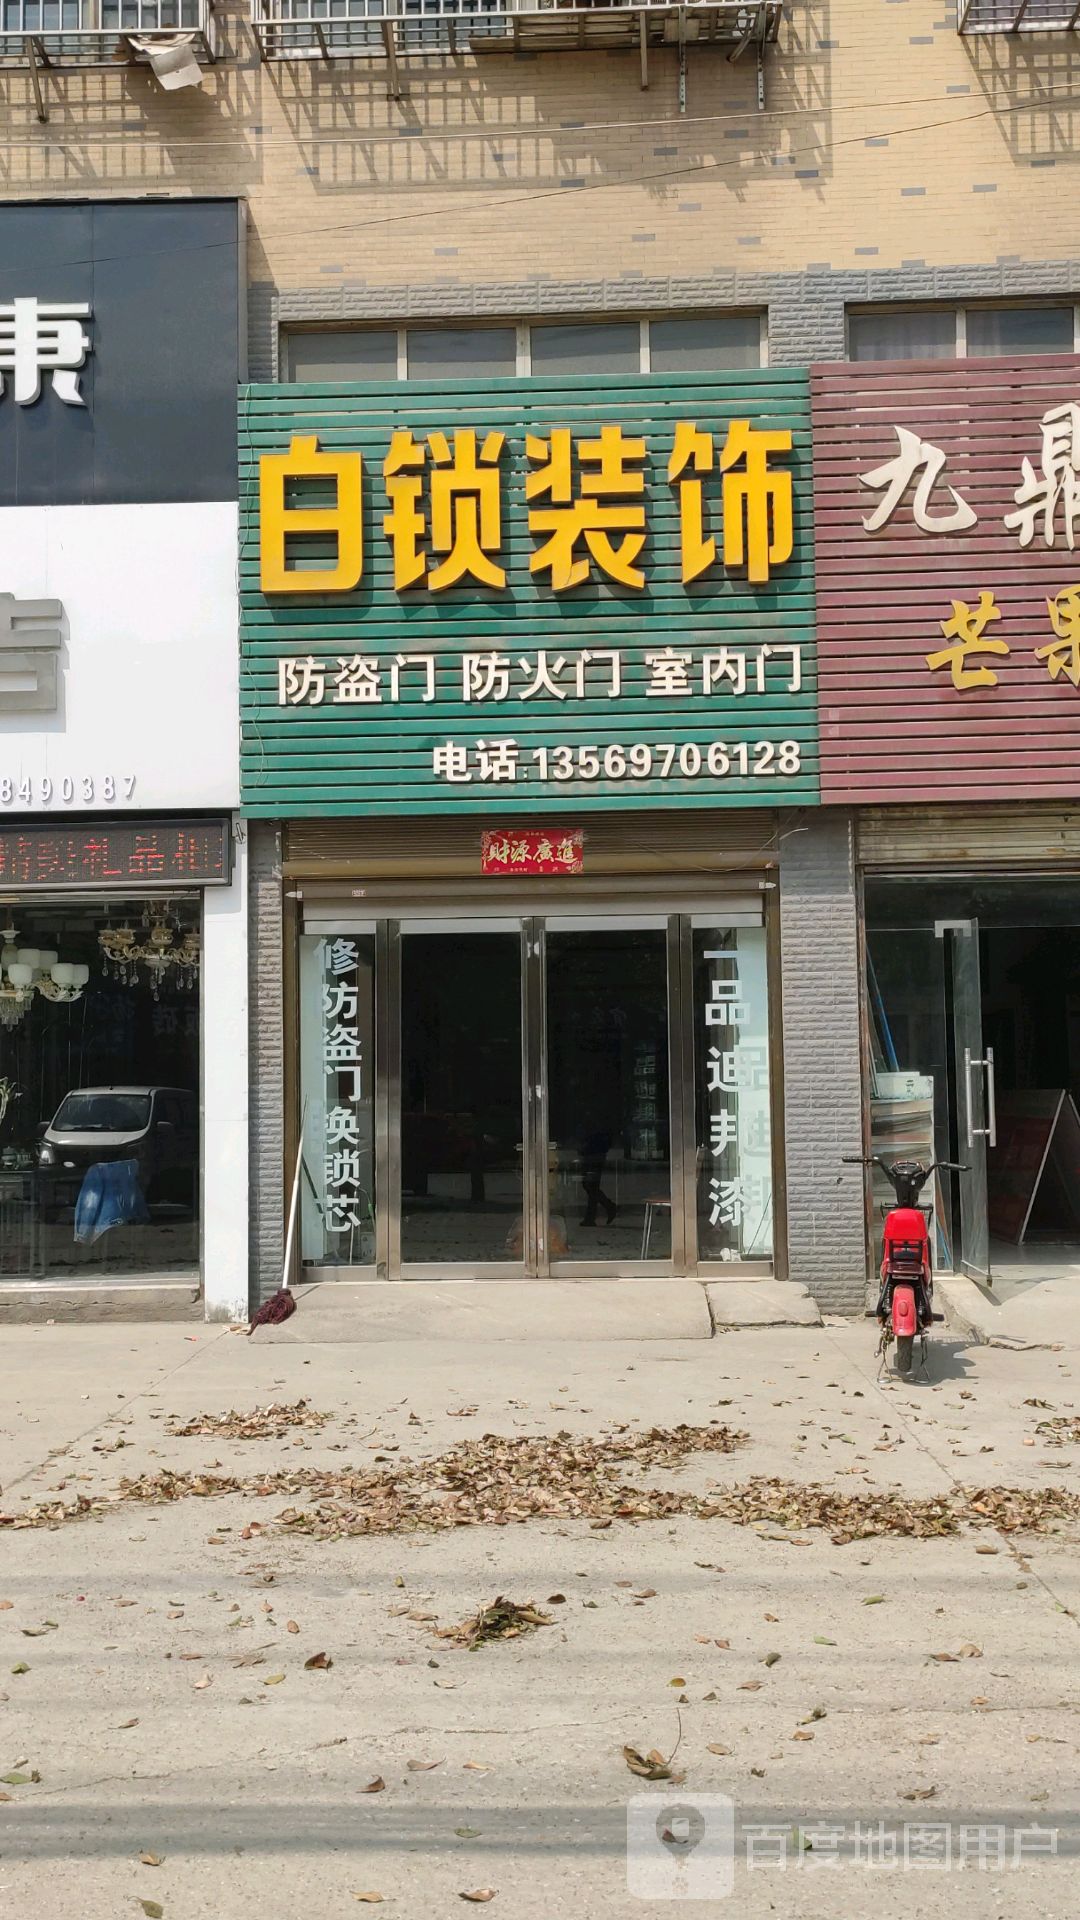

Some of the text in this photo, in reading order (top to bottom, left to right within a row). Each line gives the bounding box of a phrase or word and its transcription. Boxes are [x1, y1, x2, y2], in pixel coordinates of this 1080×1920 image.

[258, 420, 795, 595] 白锁装饰
[277, 645, 801, 705] 防盗门 防火门 室内门
[0, 774, 137, 803] 8490387
